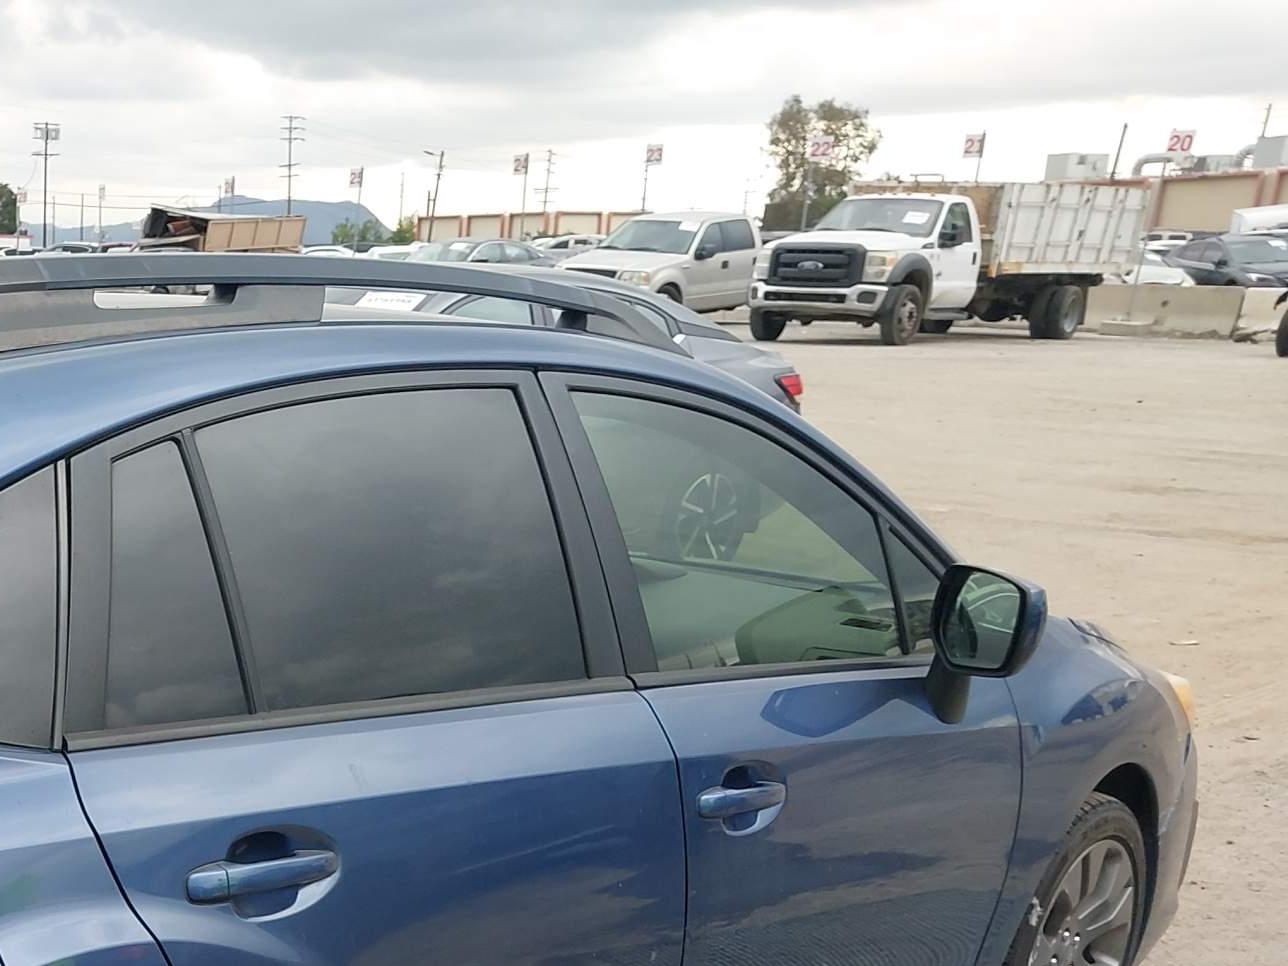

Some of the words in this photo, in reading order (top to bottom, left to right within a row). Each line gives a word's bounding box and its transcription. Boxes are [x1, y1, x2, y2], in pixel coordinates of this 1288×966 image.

[811, 142, 832, 156] 22
[1168, 134, 1193, 152] 20
[647, 148, 663, 162] 23
